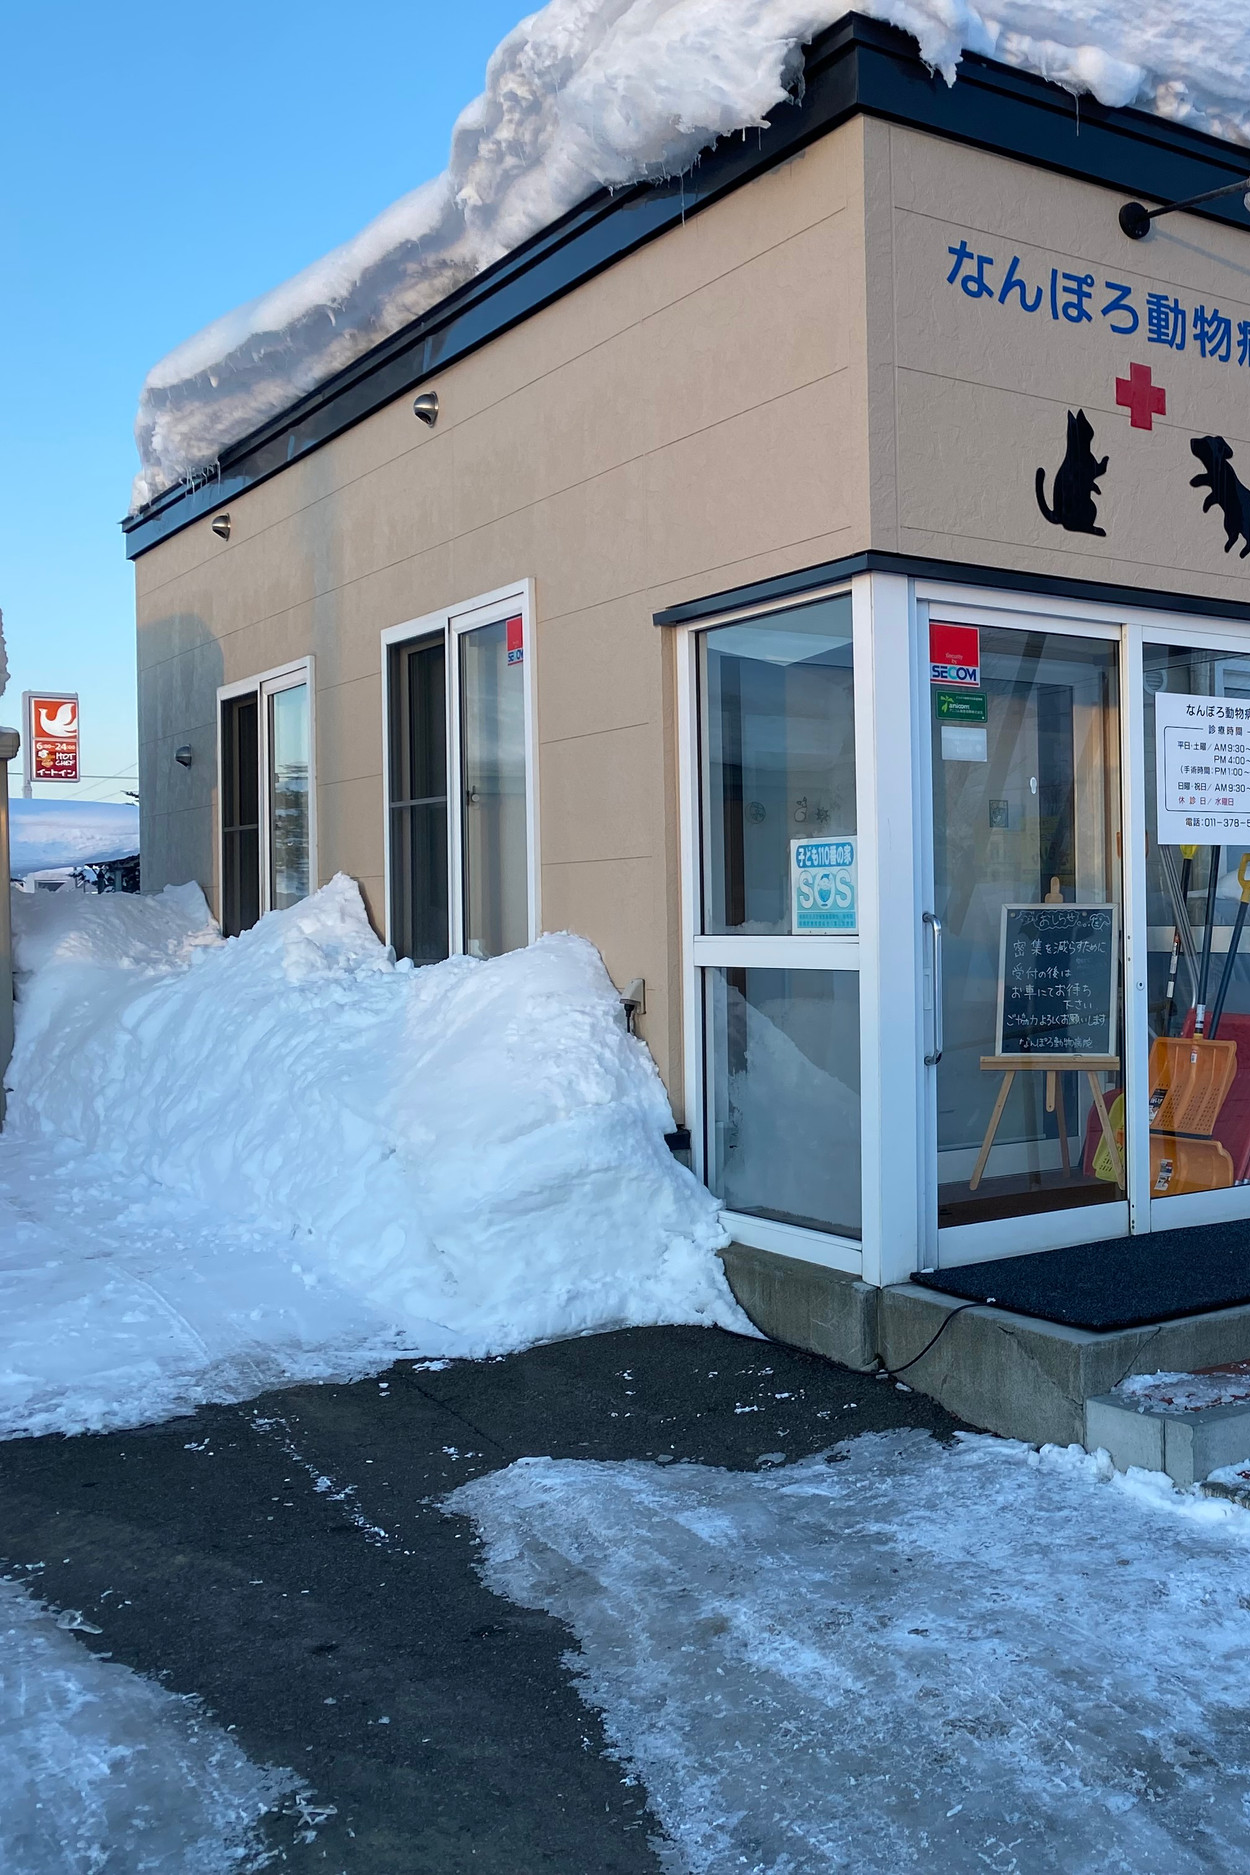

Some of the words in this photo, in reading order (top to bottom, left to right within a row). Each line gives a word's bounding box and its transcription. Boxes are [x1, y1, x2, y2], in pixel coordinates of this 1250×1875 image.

[932, 665, 976, 682] SECOM
[1208, 724, 1243, 736] 診療時間
[56, 752, 76, 760] HOT
[37, 769, 76, 777] イートイン
[798, 844, 852, 867] 子ども110番の家
[799, 868, 852, 909] SOS
[1039, 912, 1076, 927] おしらせ
[1012, 962, 1072, 981] 受付の後は
[1011, 982, 1092, 1001] お車にてお待ち
